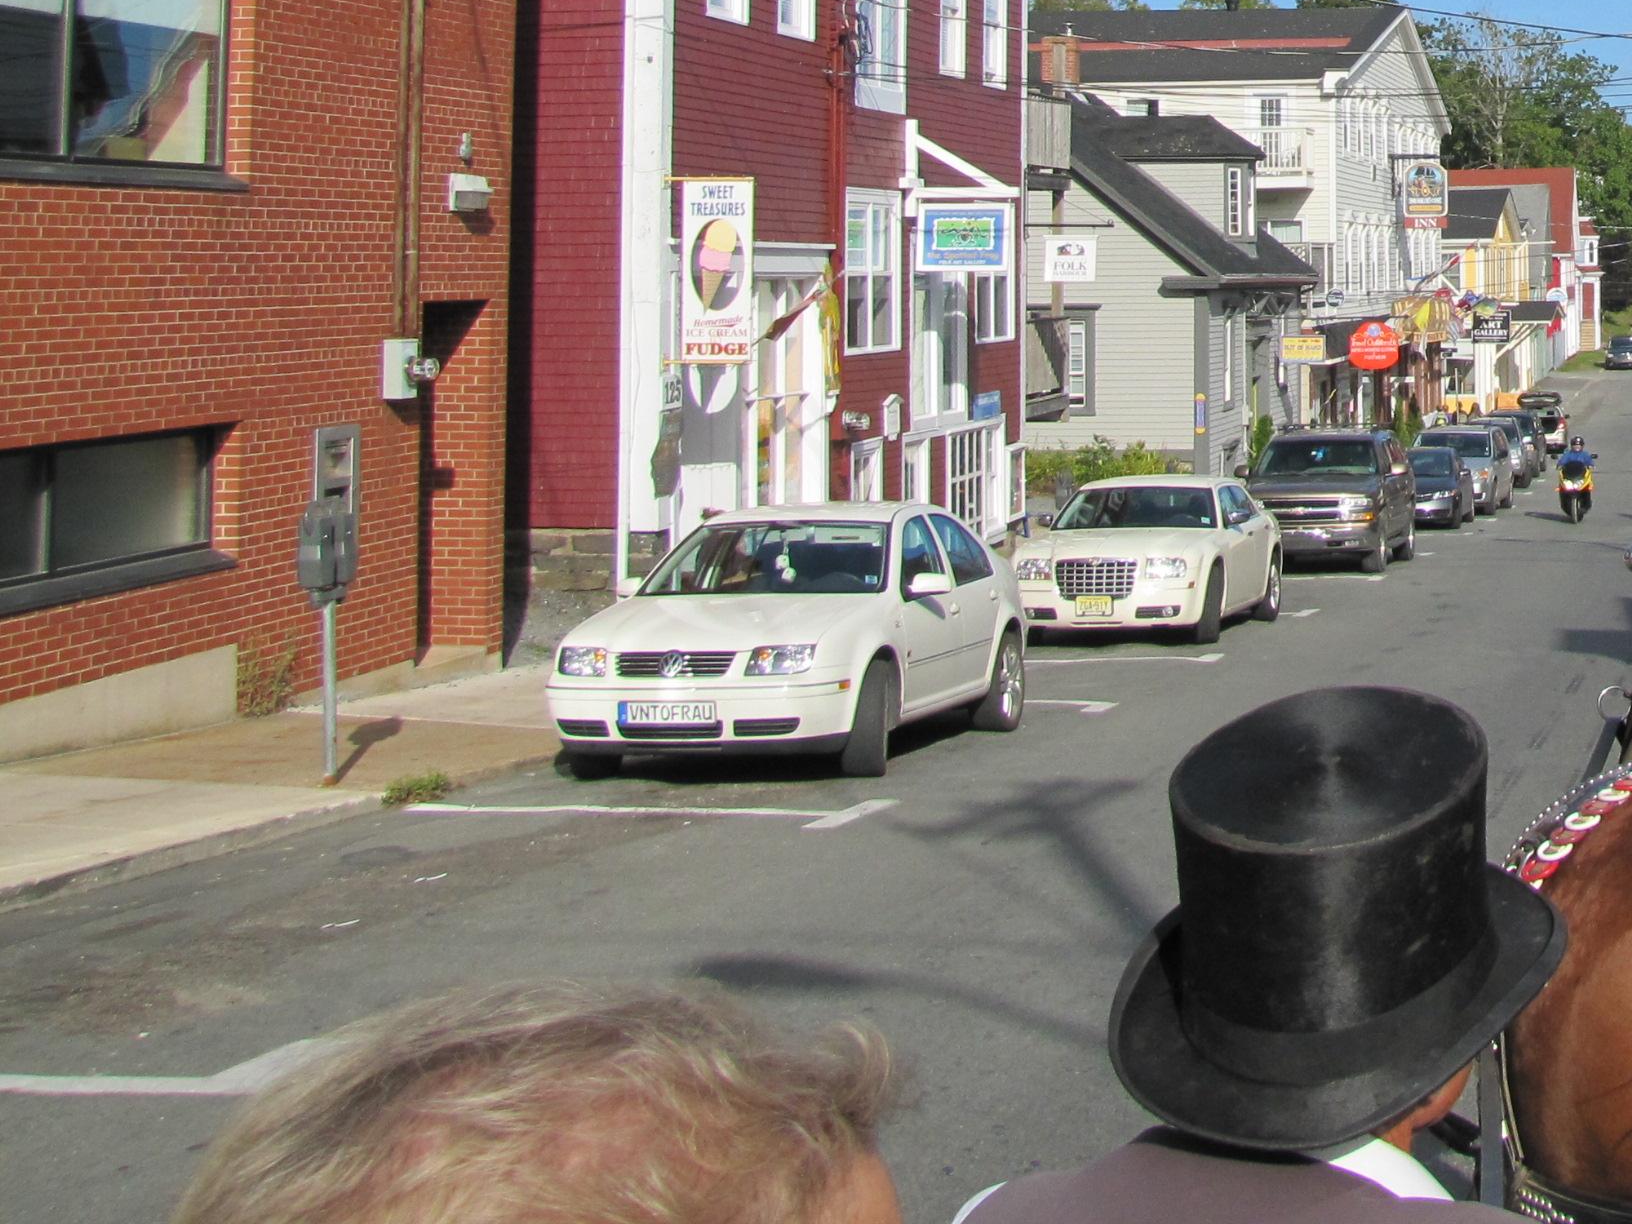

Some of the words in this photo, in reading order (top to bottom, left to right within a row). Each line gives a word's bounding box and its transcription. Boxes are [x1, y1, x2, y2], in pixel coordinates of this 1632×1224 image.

[702, 185, 735, 199] SWEET
[690, 202, 746, 216] TREASURES
[1414, 218, 1438, 228] INN
[1053, 261, 1087, 270] FOLK
[709, 328, 748, 336] CREAM
[685, 343, 748, 355] FUDGE
[664, 379, 682, 404] 125
[629, 705, 713, 721] VNTOFRAU
